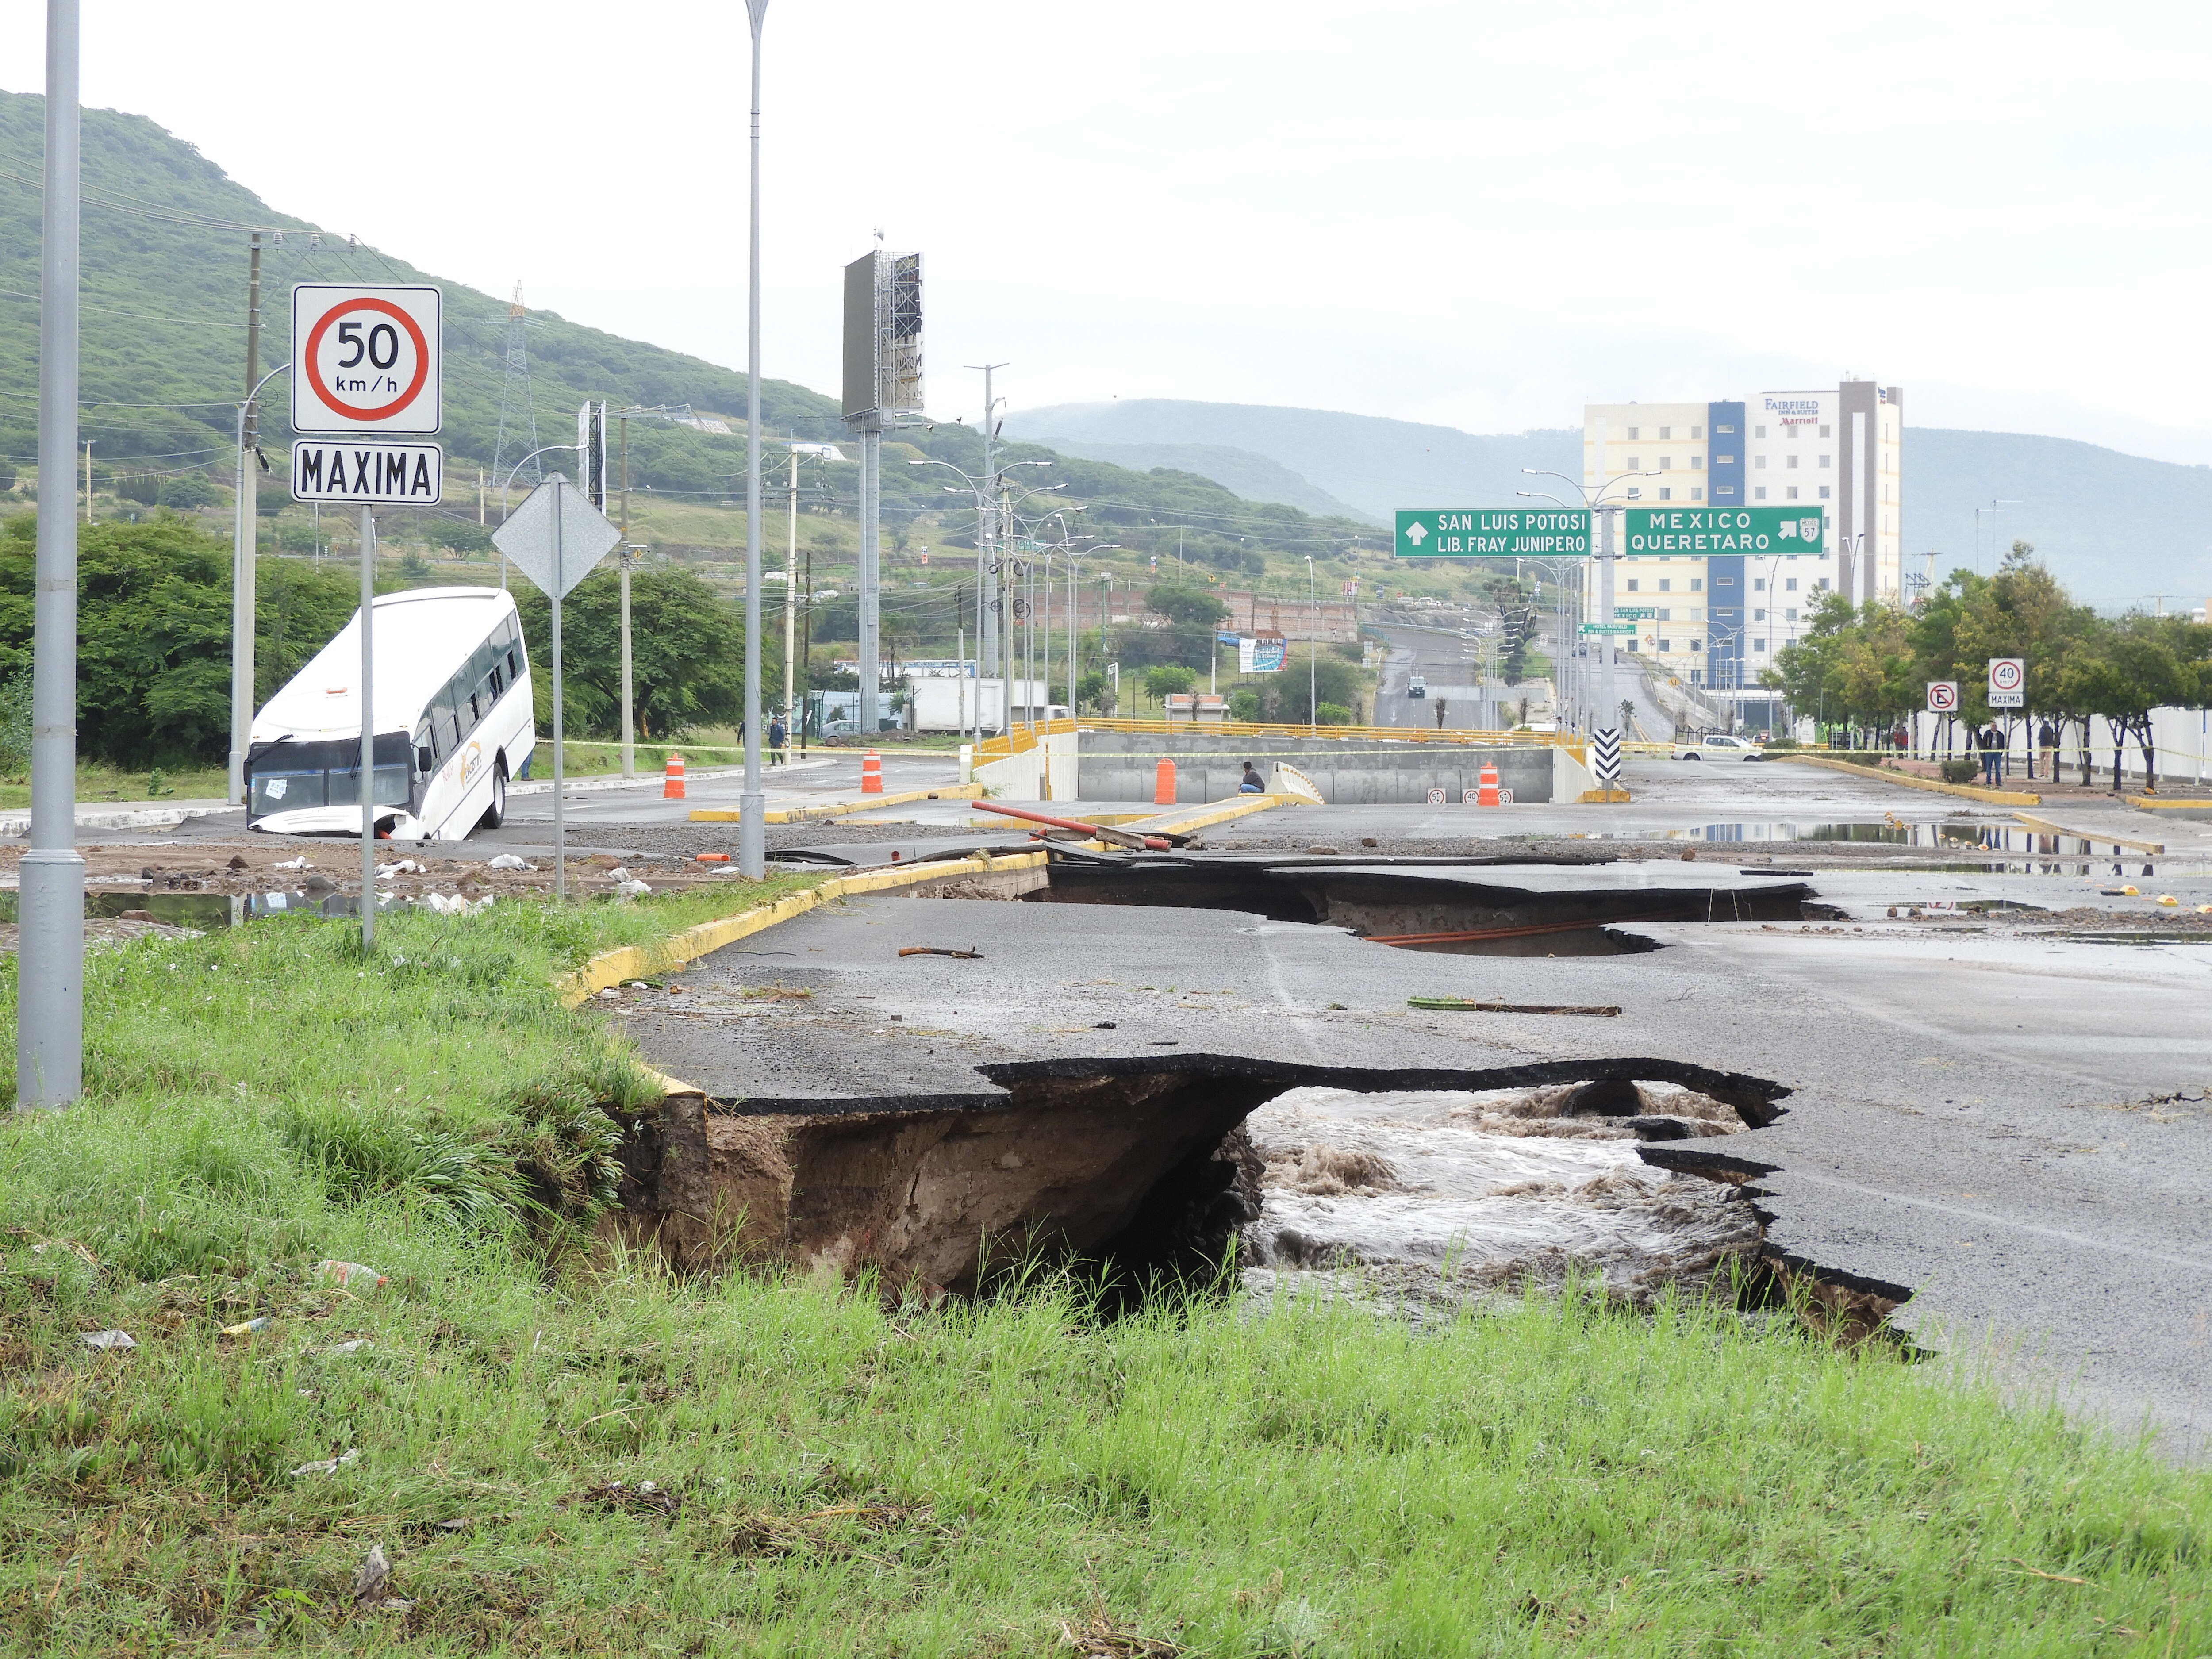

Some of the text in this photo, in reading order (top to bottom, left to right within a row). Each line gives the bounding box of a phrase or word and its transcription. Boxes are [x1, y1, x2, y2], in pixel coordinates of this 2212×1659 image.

[338, 322, 399, 369] 50
[336, 376, 397, 392] km/h
[1765, 399, 1818, 411] FAIRFIELD
[1779, 417, 1818, 426] Marriott
[302, 449, 431, 496] MAXIMA
[1438, 514, 1585, 530] SAN LUIS POTOSI
[1650, 513, 1751, 529] MEXICO
[1805, 528, 1815, 537] 57
[1438, 536, 1585, 552] LIB. FRAY JUNIPERO
[1631, 534, 1769, 550] QUERETARO
[2000, 668, 2014, 678] 40
[1991, 695, 2020, 704] MAXIMA
